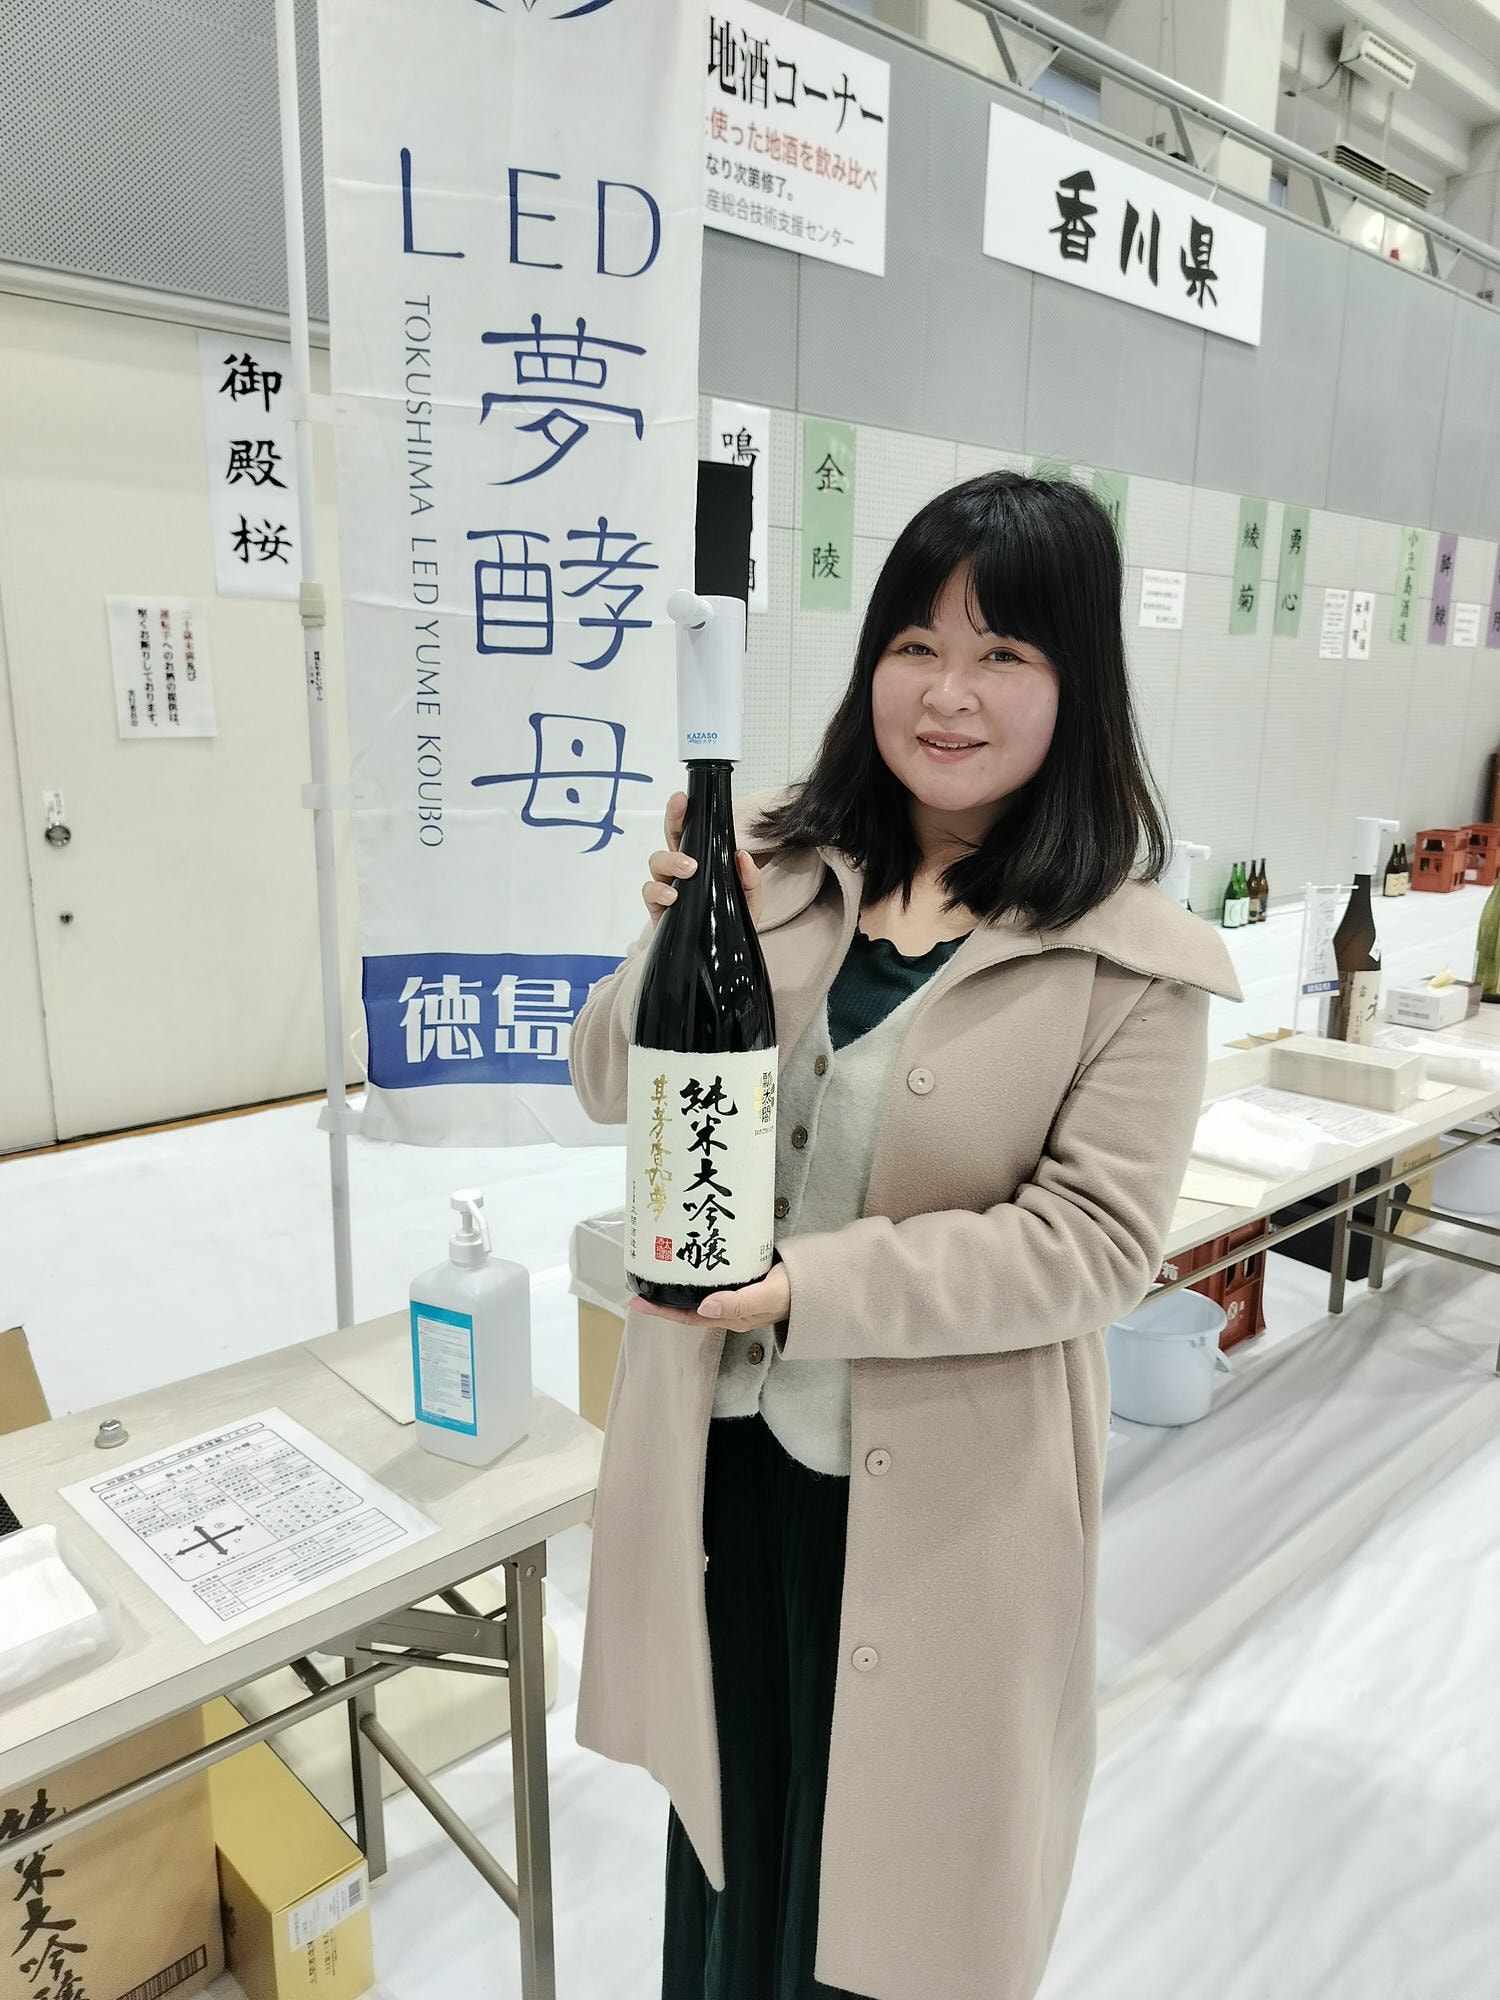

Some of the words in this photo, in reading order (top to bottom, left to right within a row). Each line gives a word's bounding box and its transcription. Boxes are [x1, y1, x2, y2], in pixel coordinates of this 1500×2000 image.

[707, 16, 885, 135] 地酒コーナー
[705, 107, 879, 193] 使った地酒を飲み比べ
[400, 146, 662, 279] LED
[1047, 169, 1221, 311] 香川県
[218, 352, 293, 566] 御殿桜
[404, 294, 436, 517] TOKUSHIMA
[411, 538, 440, 605] LED
[811, 452, 845, 580] 金陵
[1237, 521, 1261, 615] 綾菊
[1280, 528, 1303, 612] 勇心
[466, 312, 660, 855] 夢酵母
[415, 619, 442, 716] YUME
[417, 734, 444, 849] KOUBO
[687, 732, 718, 740] KAZASO
[398, 973, 595, 1064] 徳島
[676, 1075, 739, 1272] 純米大吟醸
